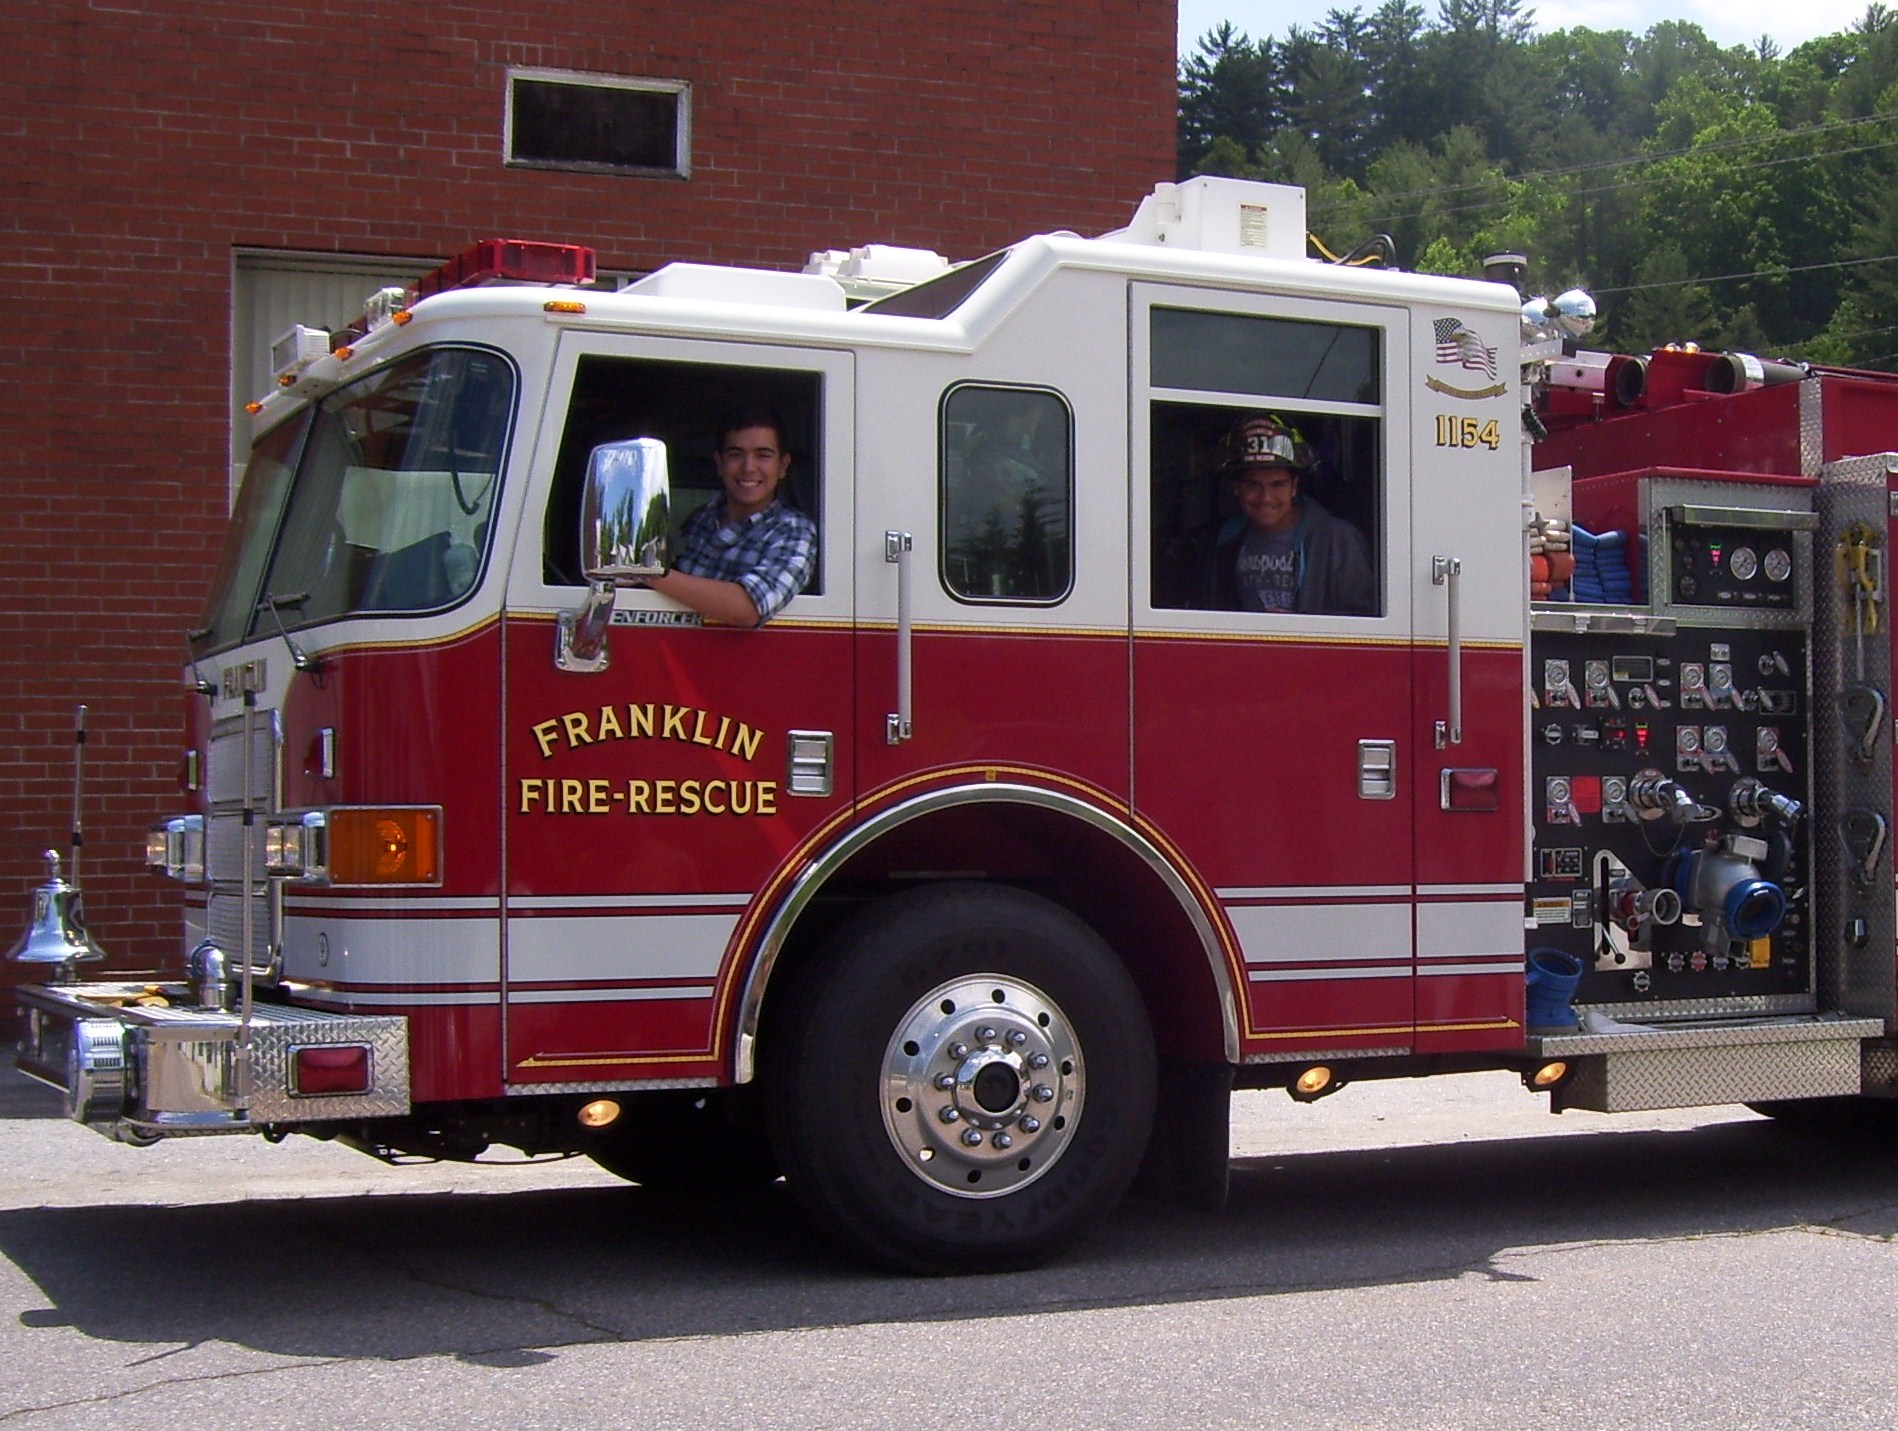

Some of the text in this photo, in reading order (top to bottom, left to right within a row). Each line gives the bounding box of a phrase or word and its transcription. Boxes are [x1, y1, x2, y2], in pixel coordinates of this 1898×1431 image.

[1247, 436, 1272, 454] 31
[1435, 415, 1501, 451] 1154
[608, 609, 704, 626] ENFORCER
[532, 703, 765, 762] FRANKLIN
[519, 778, 779, 816] FIRE-RESCUE
